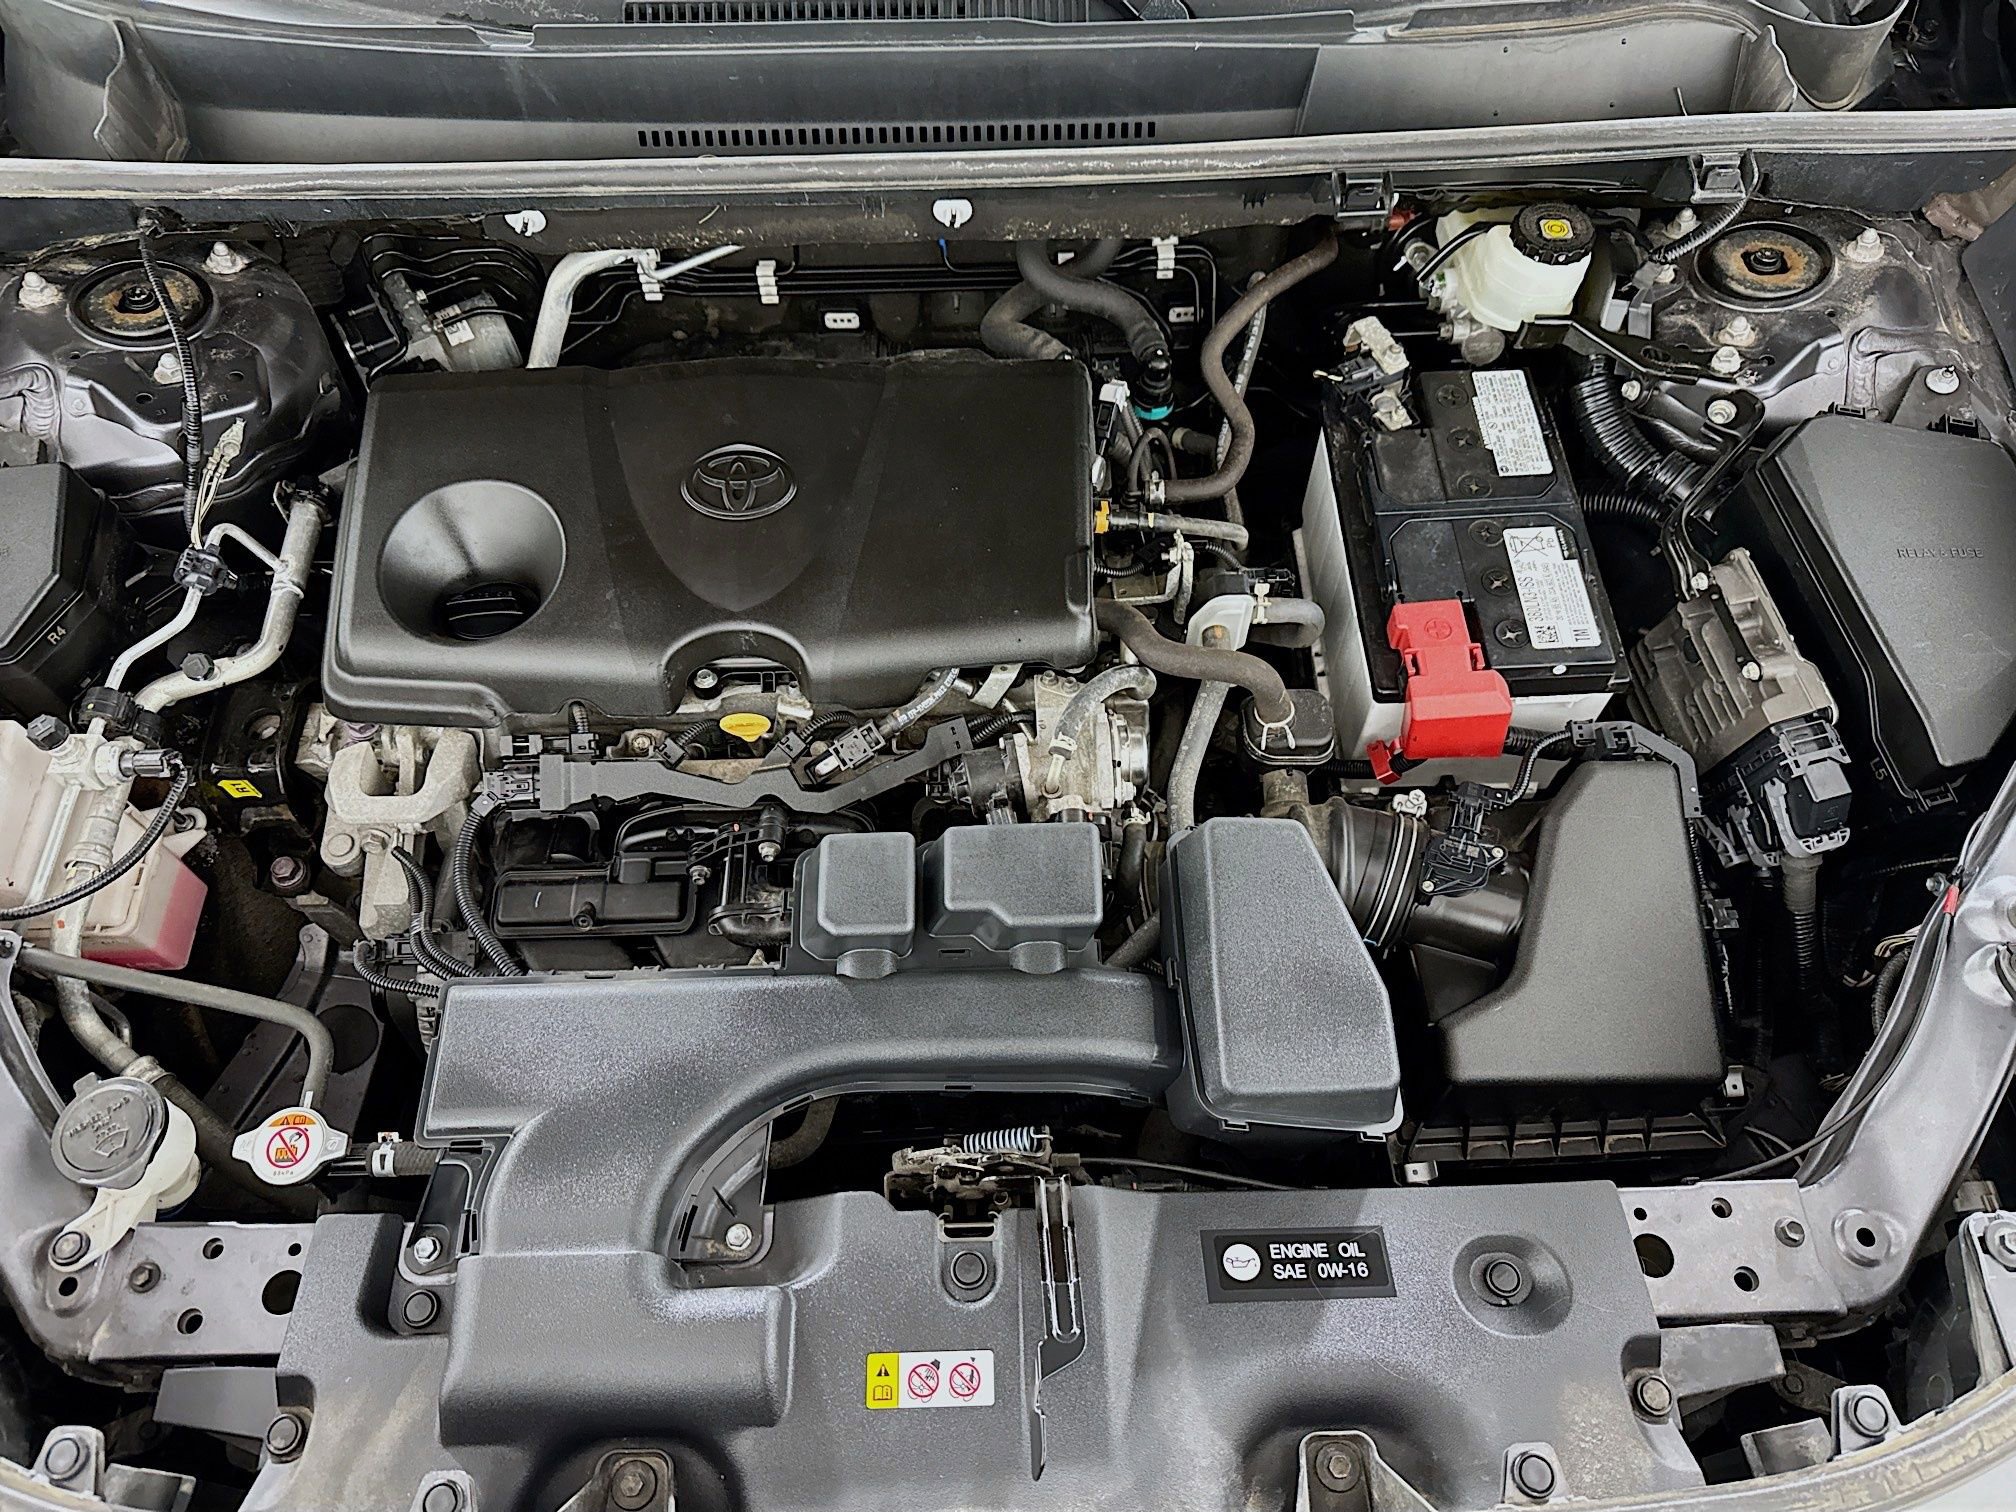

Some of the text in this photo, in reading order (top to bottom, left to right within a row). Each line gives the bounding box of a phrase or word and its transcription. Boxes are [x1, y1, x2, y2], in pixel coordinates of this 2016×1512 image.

[1896, 547, 1935, 558] RELAY
[1950, 547, 1983, 558] FUSE
[47, 625, 67, 645] R4
[1573, 628, 1591, 643] TM
[1870, 757, 1888, 780] L5
[1269, 1242, 1366, 1259] ENGINE OIL
[1273, 1262, 1369, 1280] SAE 0W-16
